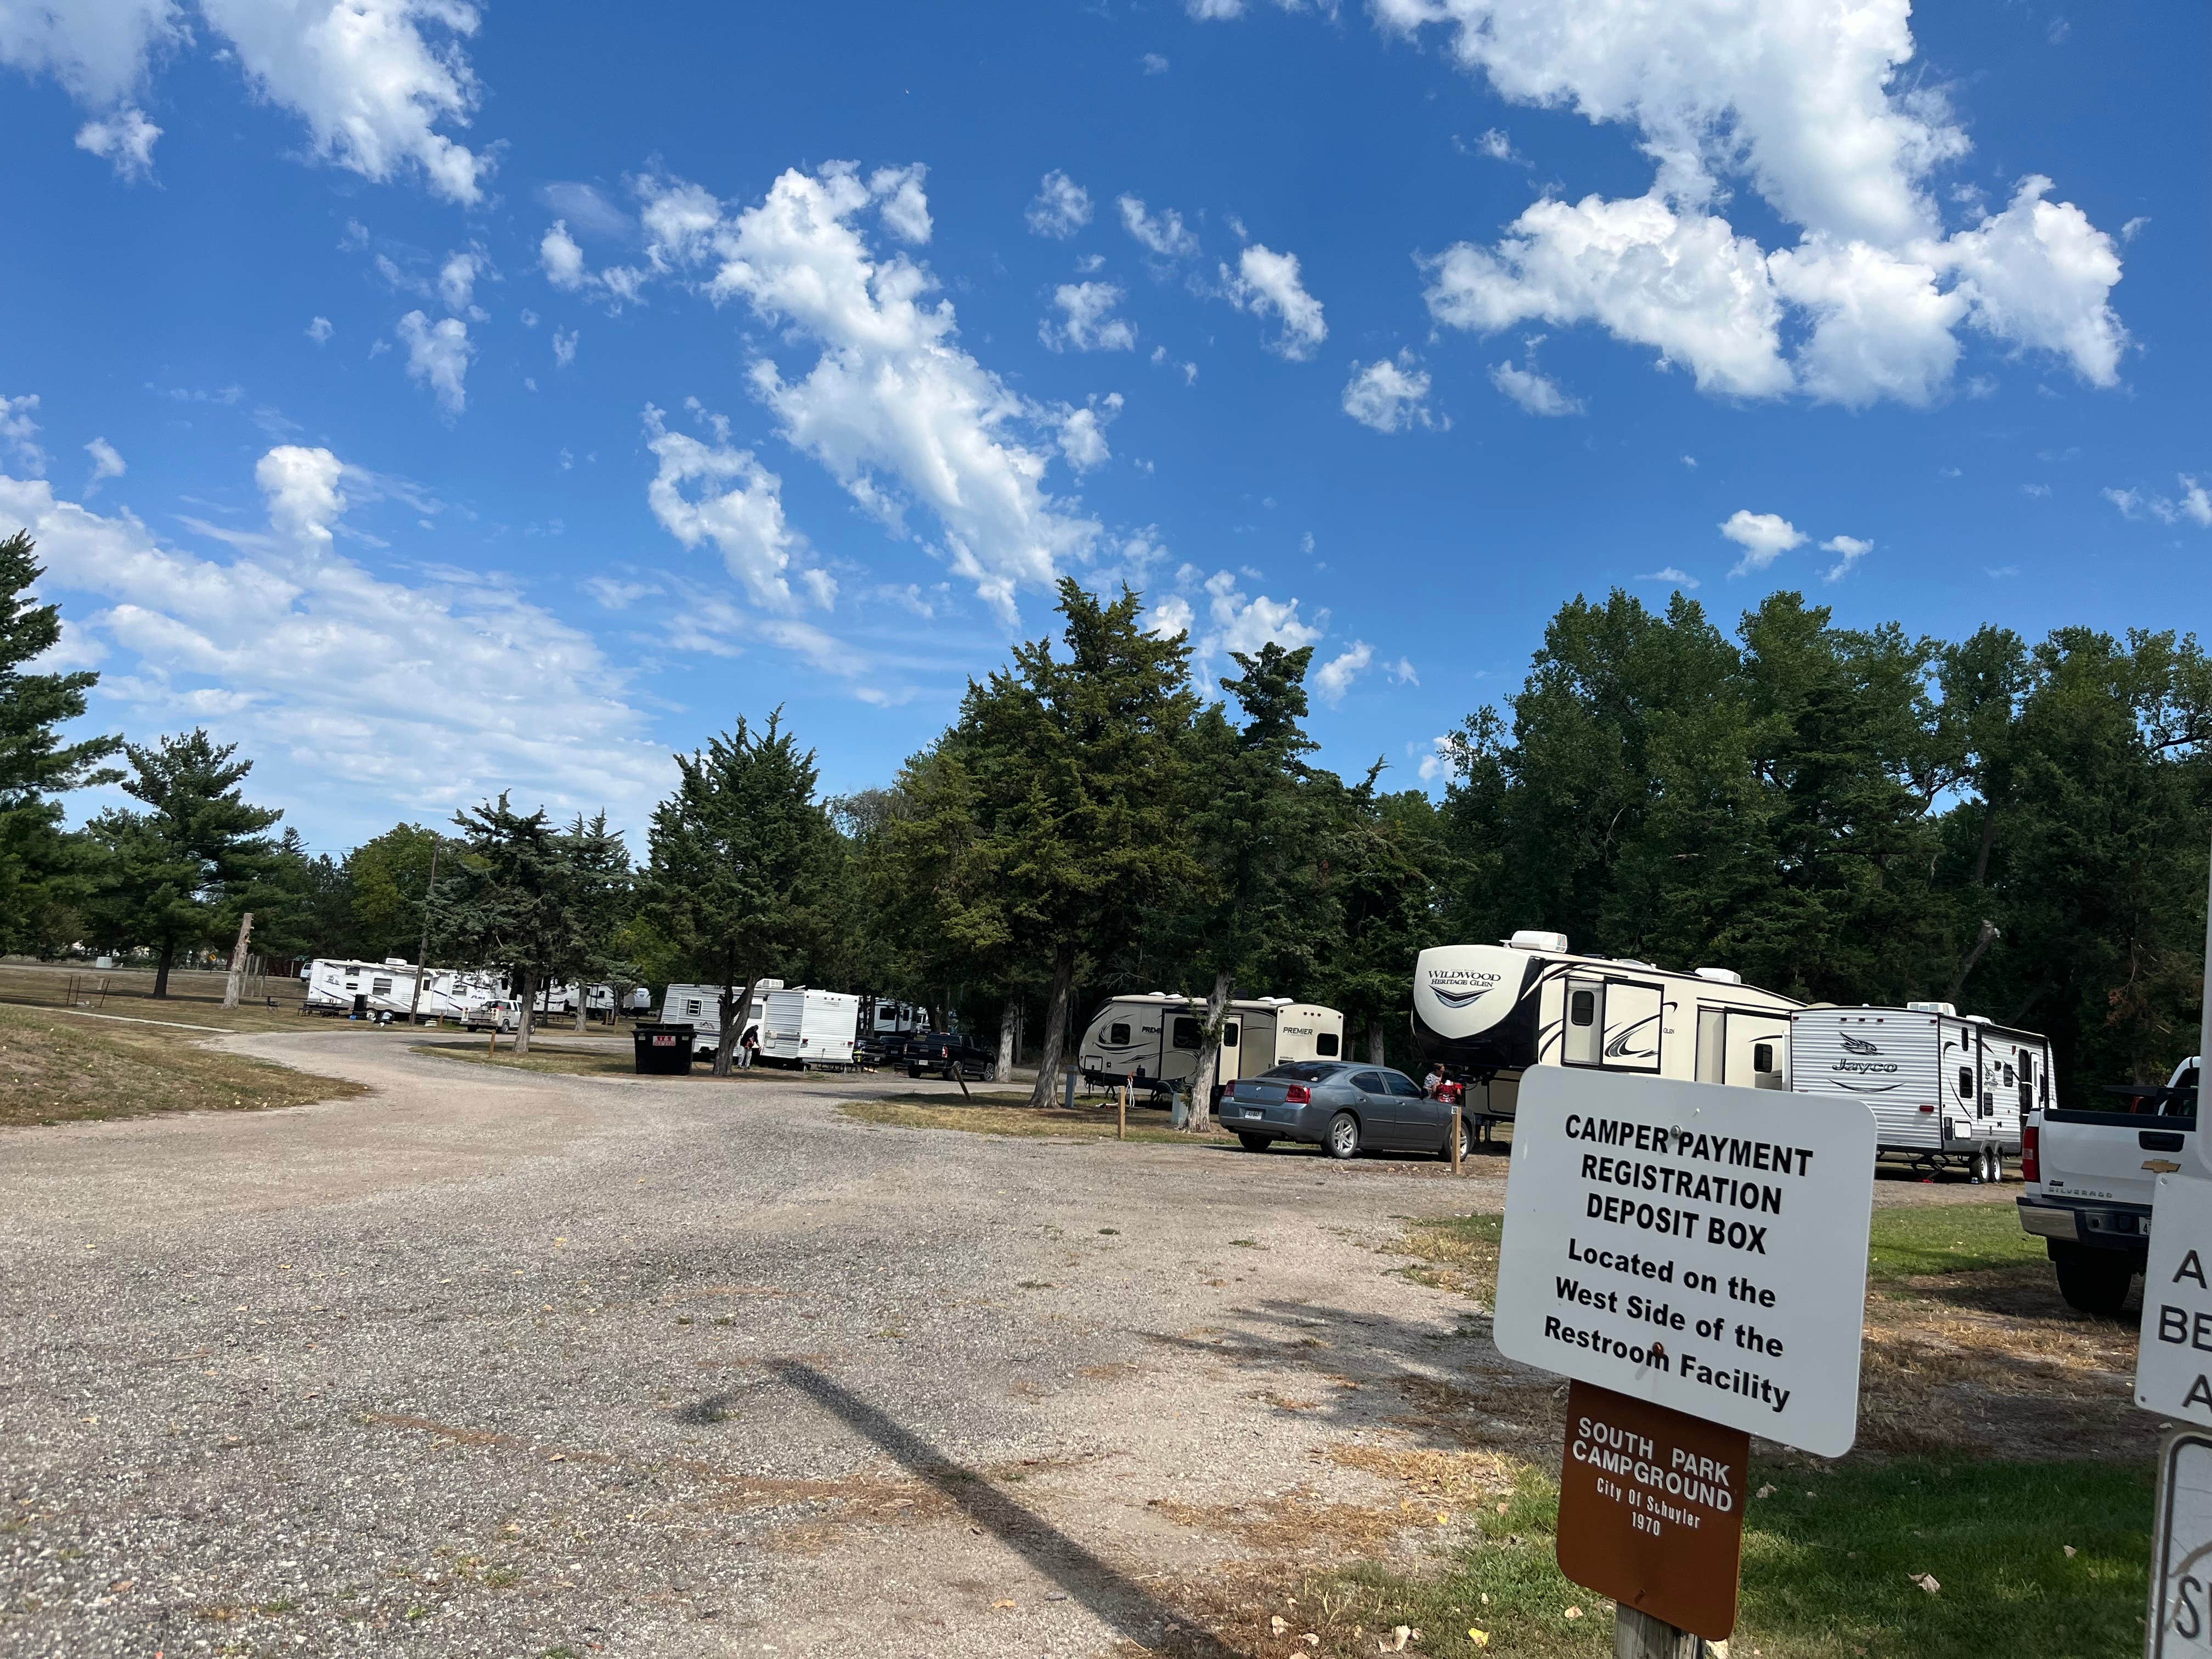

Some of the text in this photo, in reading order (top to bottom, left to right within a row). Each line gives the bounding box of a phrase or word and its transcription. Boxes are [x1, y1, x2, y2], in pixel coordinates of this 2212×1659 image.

[1428, 970, 1501, 981] WILDWOOD
[1283, 1027, 1313, 1035] PREMIER
[1832, 1058, 1898, 1074] Jayco
[1565, 1114, 1814, 1177] CAMPER PAYMENT
[1581, 1154, 1782, 1215] REGISTRATION
[2049, 1187, 2112, 1198] SILVERADO
[1587, 1193, 1768, 1255] DEPOSIT BOX
[1568, 1238, 1776, 1308] Located on the
[1556, 1276, 1783, 1357] West Side of the
[1544, 1315, 1791, 1413] Restroom Facility
[1572, 1440, 1732, 1511] CAMPGROUND
[1578, 1417, 1730, 1487] SOUTH PARK
[1596, 1477, 1622, 1502] City
[1628, 1489, 1641, 1507] Of
[1632, 1511, 1660, 1536] 1970
